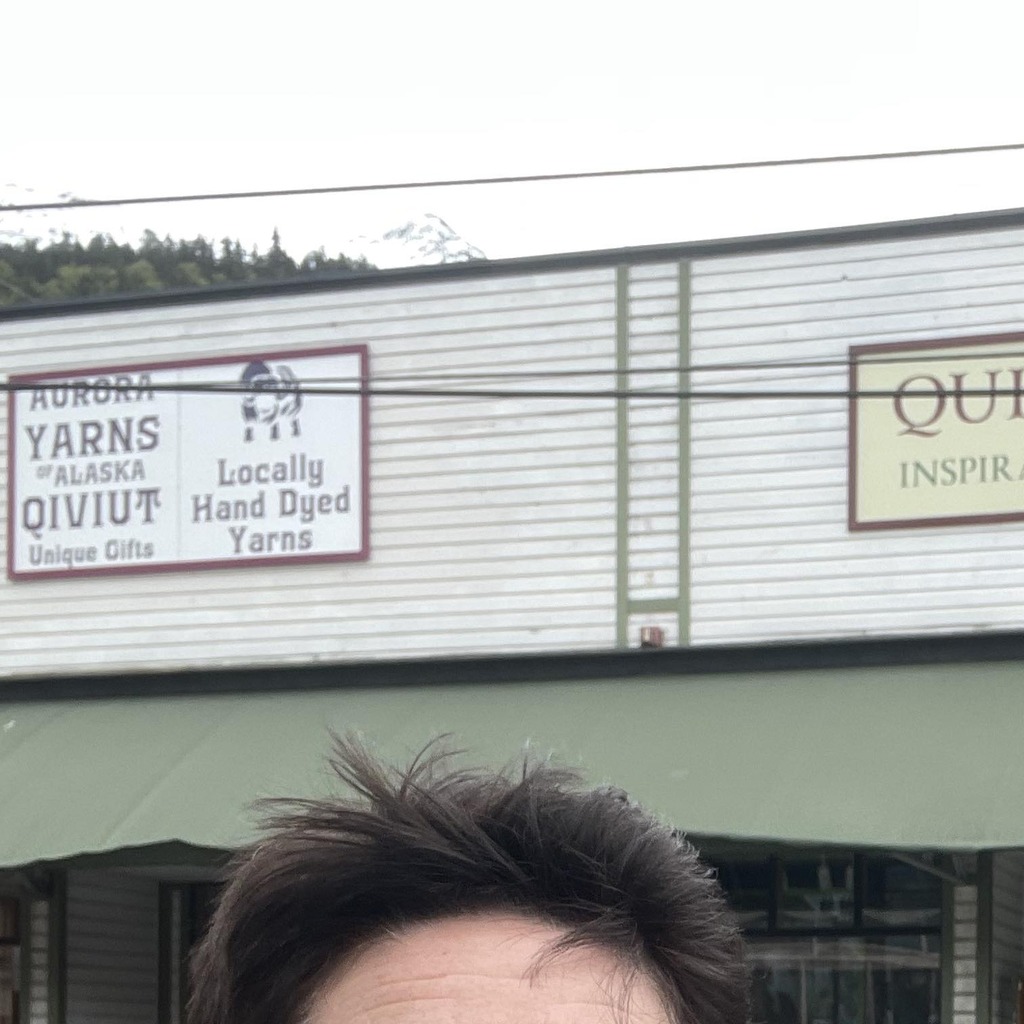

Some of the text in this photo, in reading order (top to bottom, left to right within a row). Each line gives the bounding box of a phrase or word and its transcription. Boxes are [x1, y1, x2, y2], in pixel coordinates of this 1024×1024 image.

[30, 374, 154, 411] AURORA
[25, 415, 161, 460] YARNS
[54, 459, 146, 487] ALASKA
[217, 453, 324, 488] Locally
[23, 487, 161, 539] QIVIUT
[192, 485, 350, 523] Hand Dyed
[29, 538, 154, 569] Unique Gifts
[228, 525, 313, 553] Yarns
